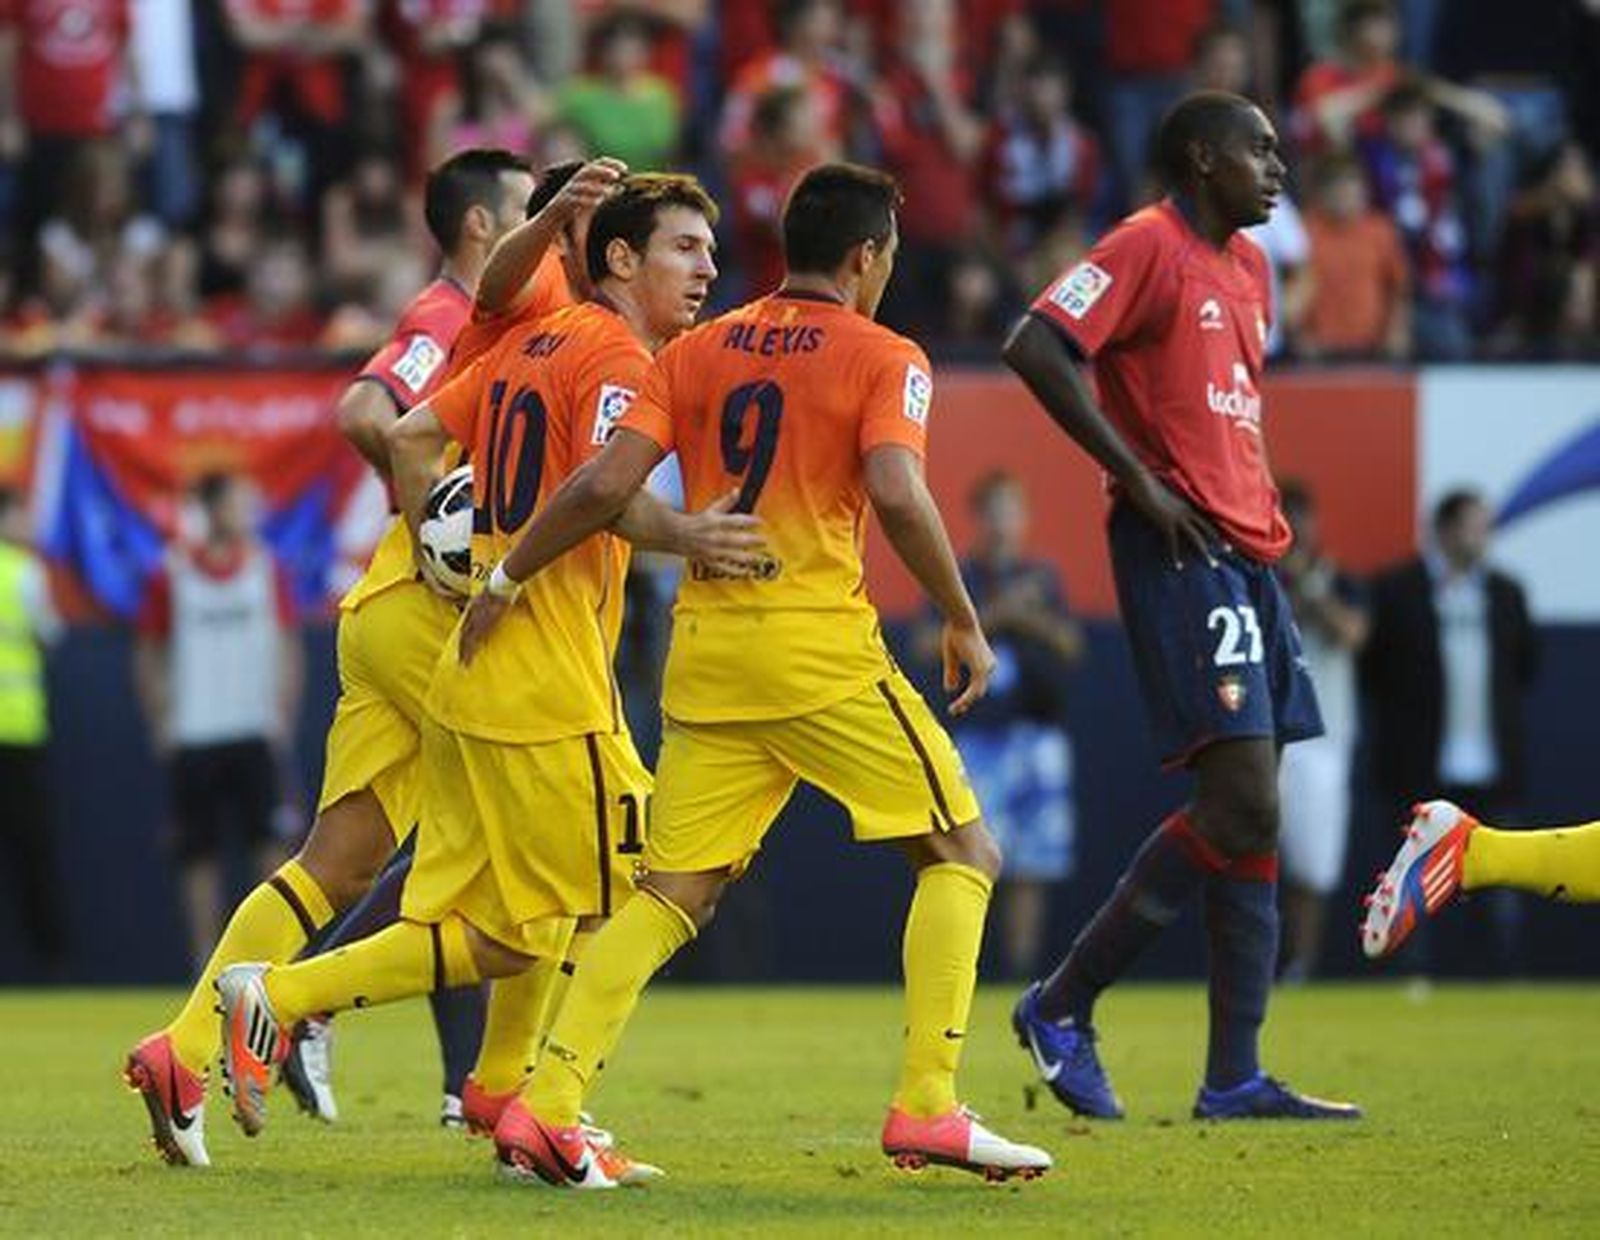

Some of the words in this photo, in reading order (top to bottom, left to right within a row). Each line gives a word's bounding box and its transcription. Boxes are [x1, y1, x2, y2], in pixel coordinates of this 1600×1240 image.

[473, 380, 548, 535] 10
[720, 377, 785, 515] 9
[1207, 604, 1263, 667] 21
